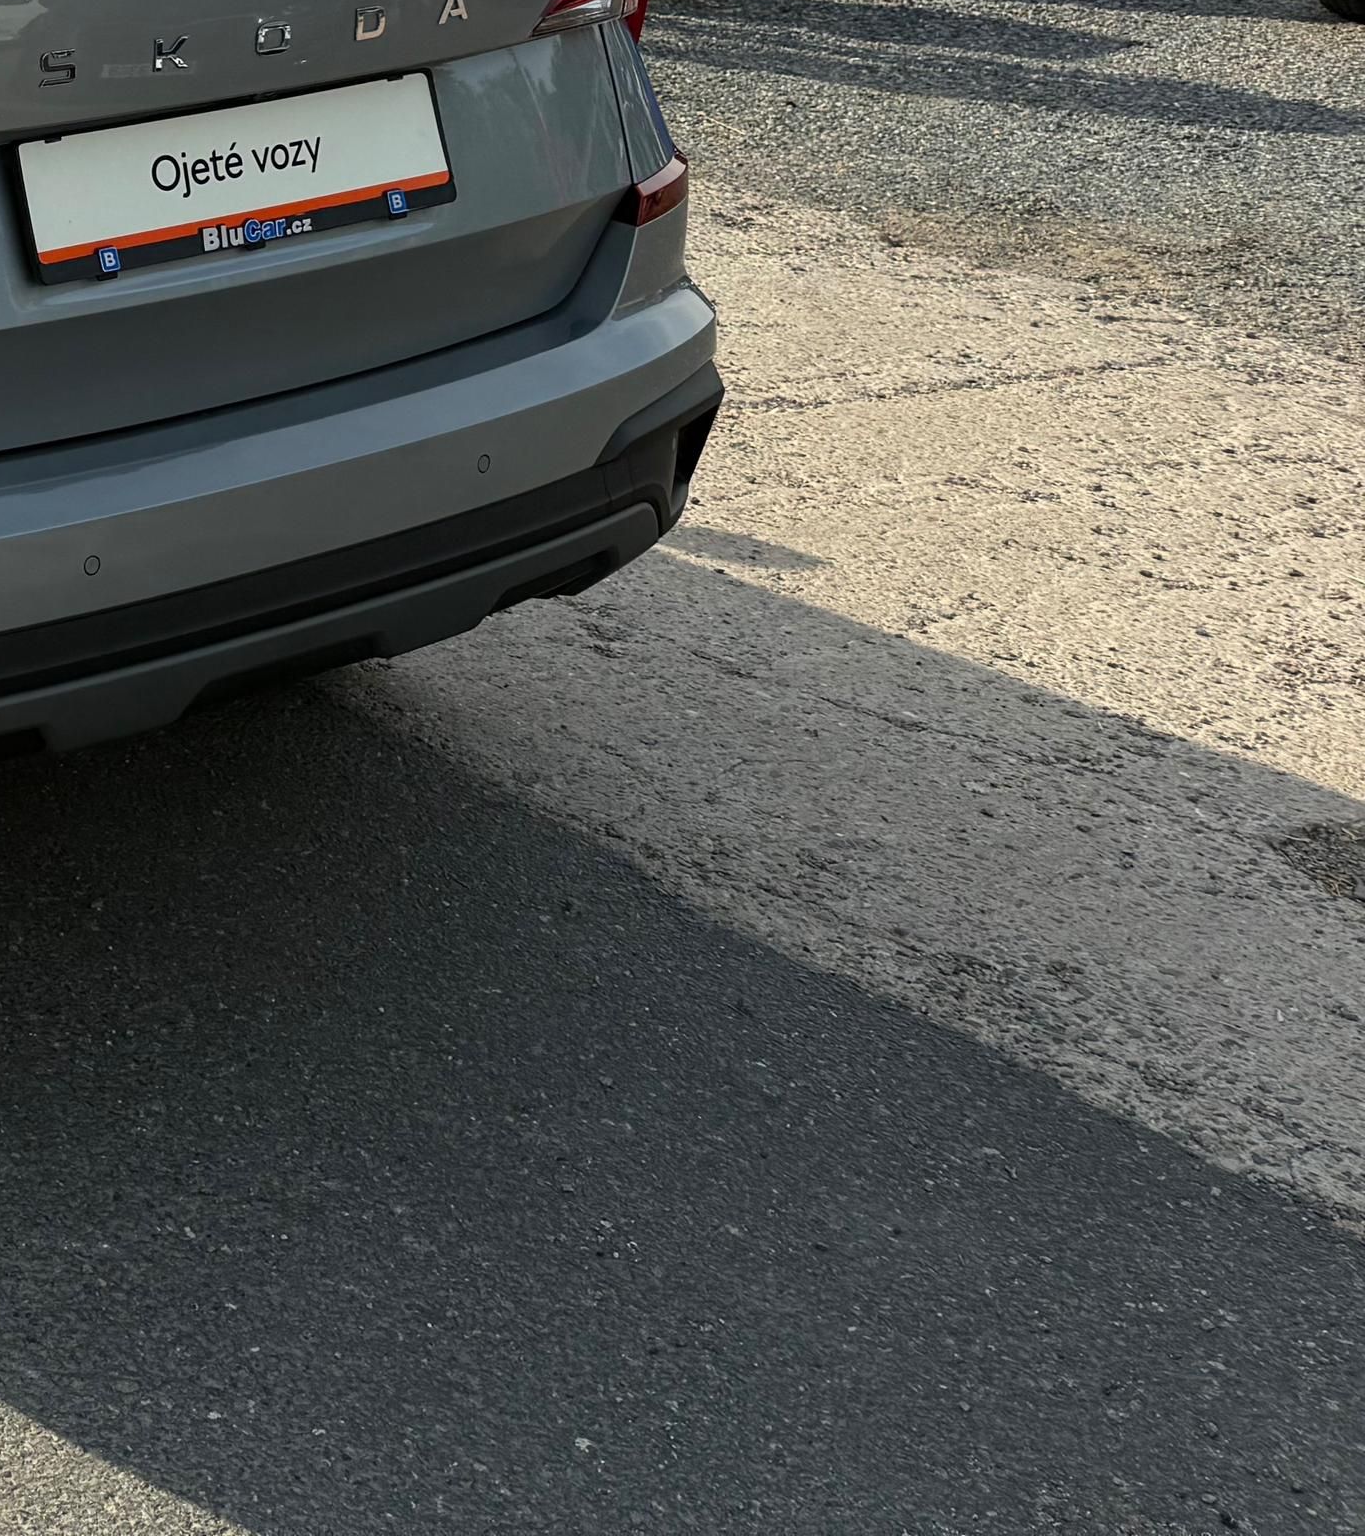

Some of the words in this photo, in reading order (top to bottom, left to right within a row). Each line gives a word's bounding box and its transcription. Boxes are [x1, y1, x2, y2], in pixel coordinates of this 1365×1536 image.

[151, 142, 244, 198] Ojeté
[252, 137, 321, 173] vozy
[203, 217, 312, 252] BluCar.cz
